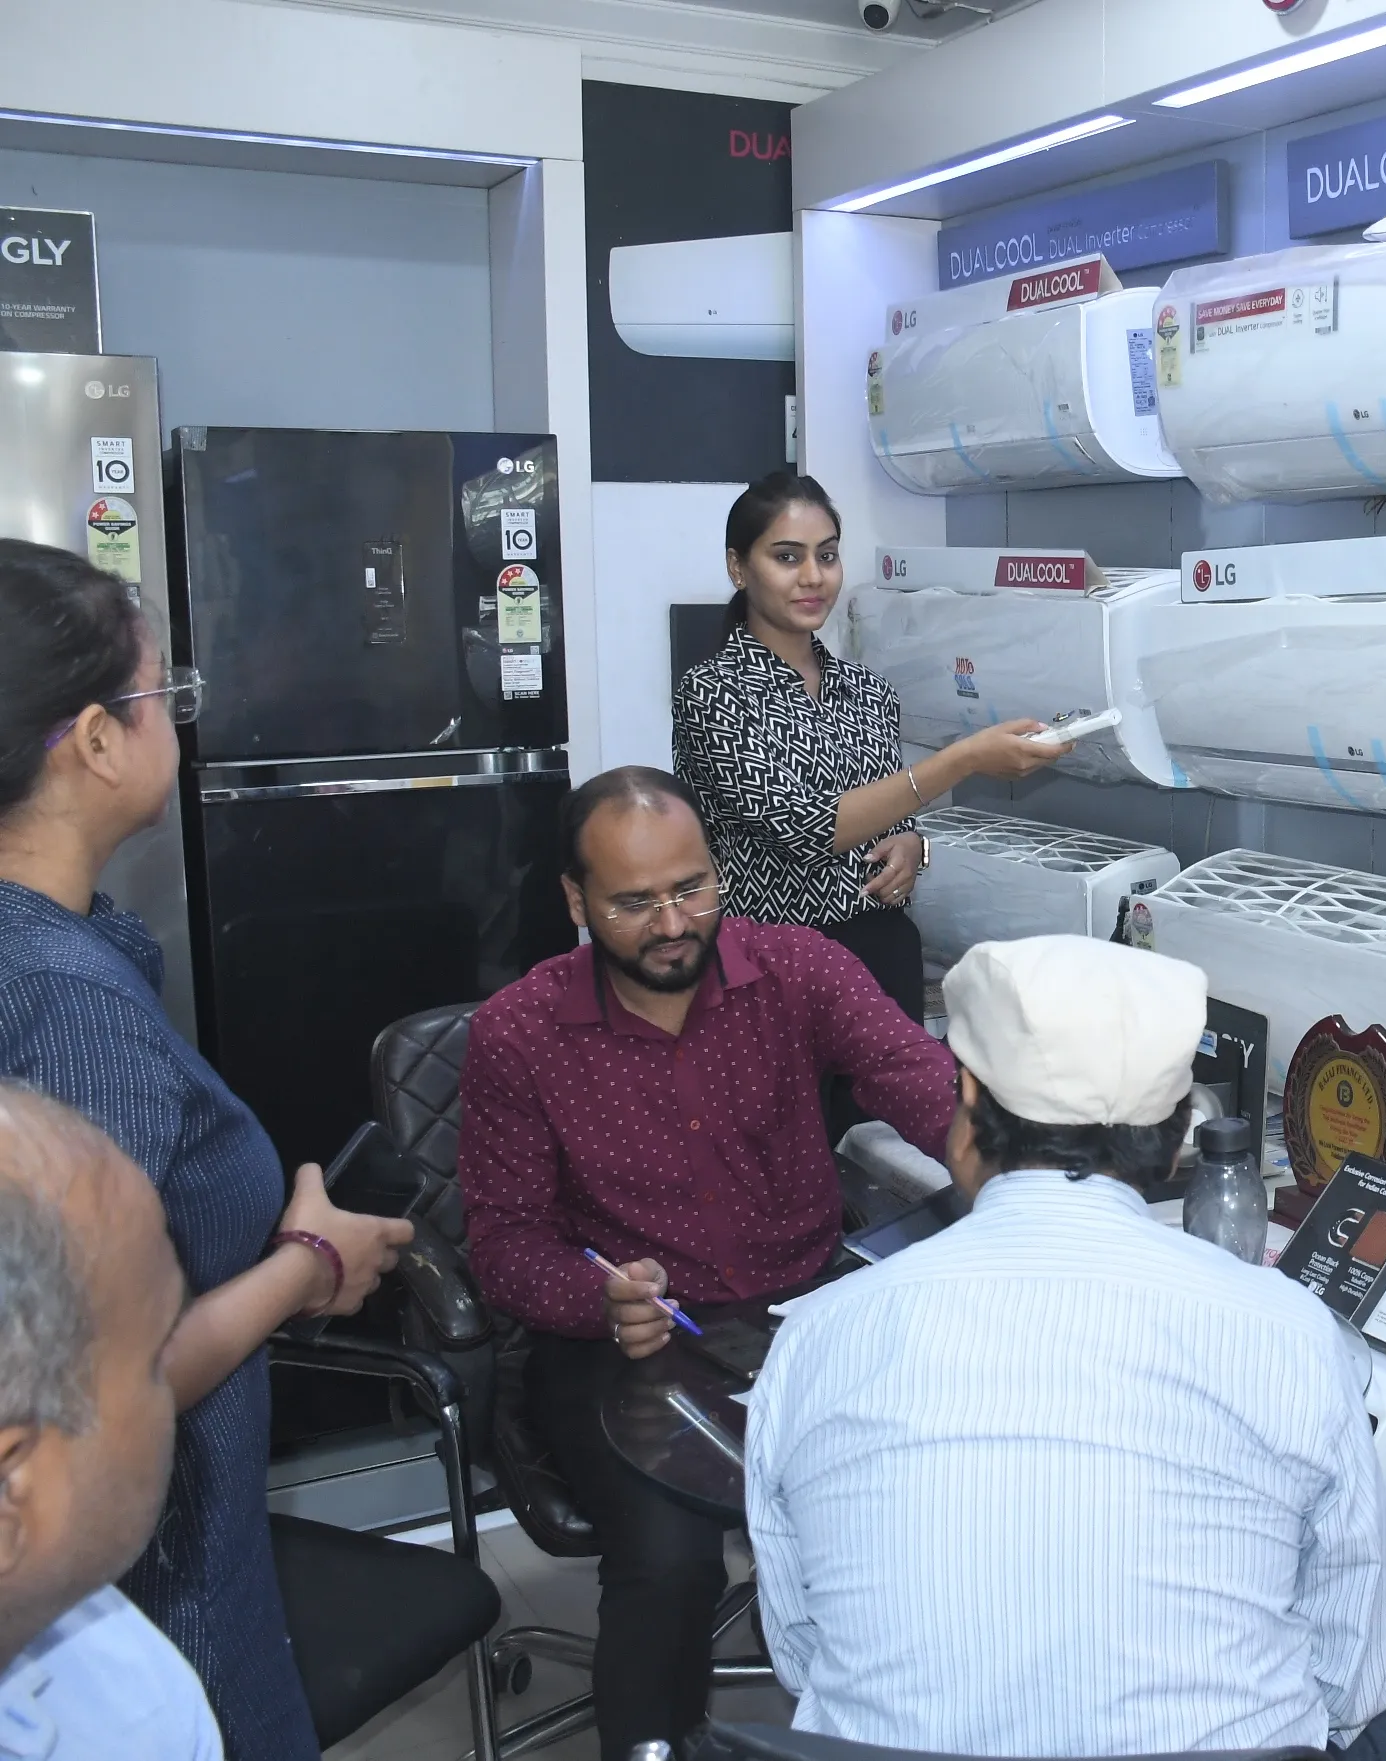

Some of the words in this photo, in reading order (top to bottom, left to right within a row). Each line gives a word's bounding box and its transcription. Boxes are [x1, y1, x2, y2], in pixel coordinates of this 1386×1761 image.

[1049, 235, 1083, 260] DUAL
[1085, 224, 1135, 254] Inverter
[1, 236, 72, 266] GLY
[950, 233, 1044, 280] DUALCOOL
[14, 311, 65, 319] COMPRESSOR
[33, 304, 76, 313] WARRANTY
[1197, 308, 1213, 320] SAVE
[1213, 304, 1235, 318] MONEY
[1235, 302, 1251, 315] SAVE
[1251, 295, 1283, 310] EVERYDAY
[904, 311, 917, 329] LG
[1217, 325, 1234, 337] DUAL
[1235, 322, 1260, 334] Inverter
[108, 384, 131, 398] LG
[96, 460, 130, 483] 10
[516, 460, 535, 473] LG
[505, 529, 533, 551] 10
[371, 547, 393, 555] ThinQ
[894, 559, 907, 577] LG
[1215, 562, 1237, 586] LG
[1336, 1064, 1362, 1085] FINANCE
[1343, 1164, 1364, 1179] Exclusive
[1364, 1171, 1386, 1186] Corrosion
[1357, 1179, 1366, 1188] for
[1366, 1182, 1380, 1194] Indian
[1308, 1258, 1333, 1273] Protection
[1311, 1251, 1326, 1262] Ocean
[1326, 1256, 1340, 1268] Black
[1347, 1266, 1361, 1277] 100%
[1315, 1285, 1326, 1296] LG
[1339, 1284, 1348, 1293] High
